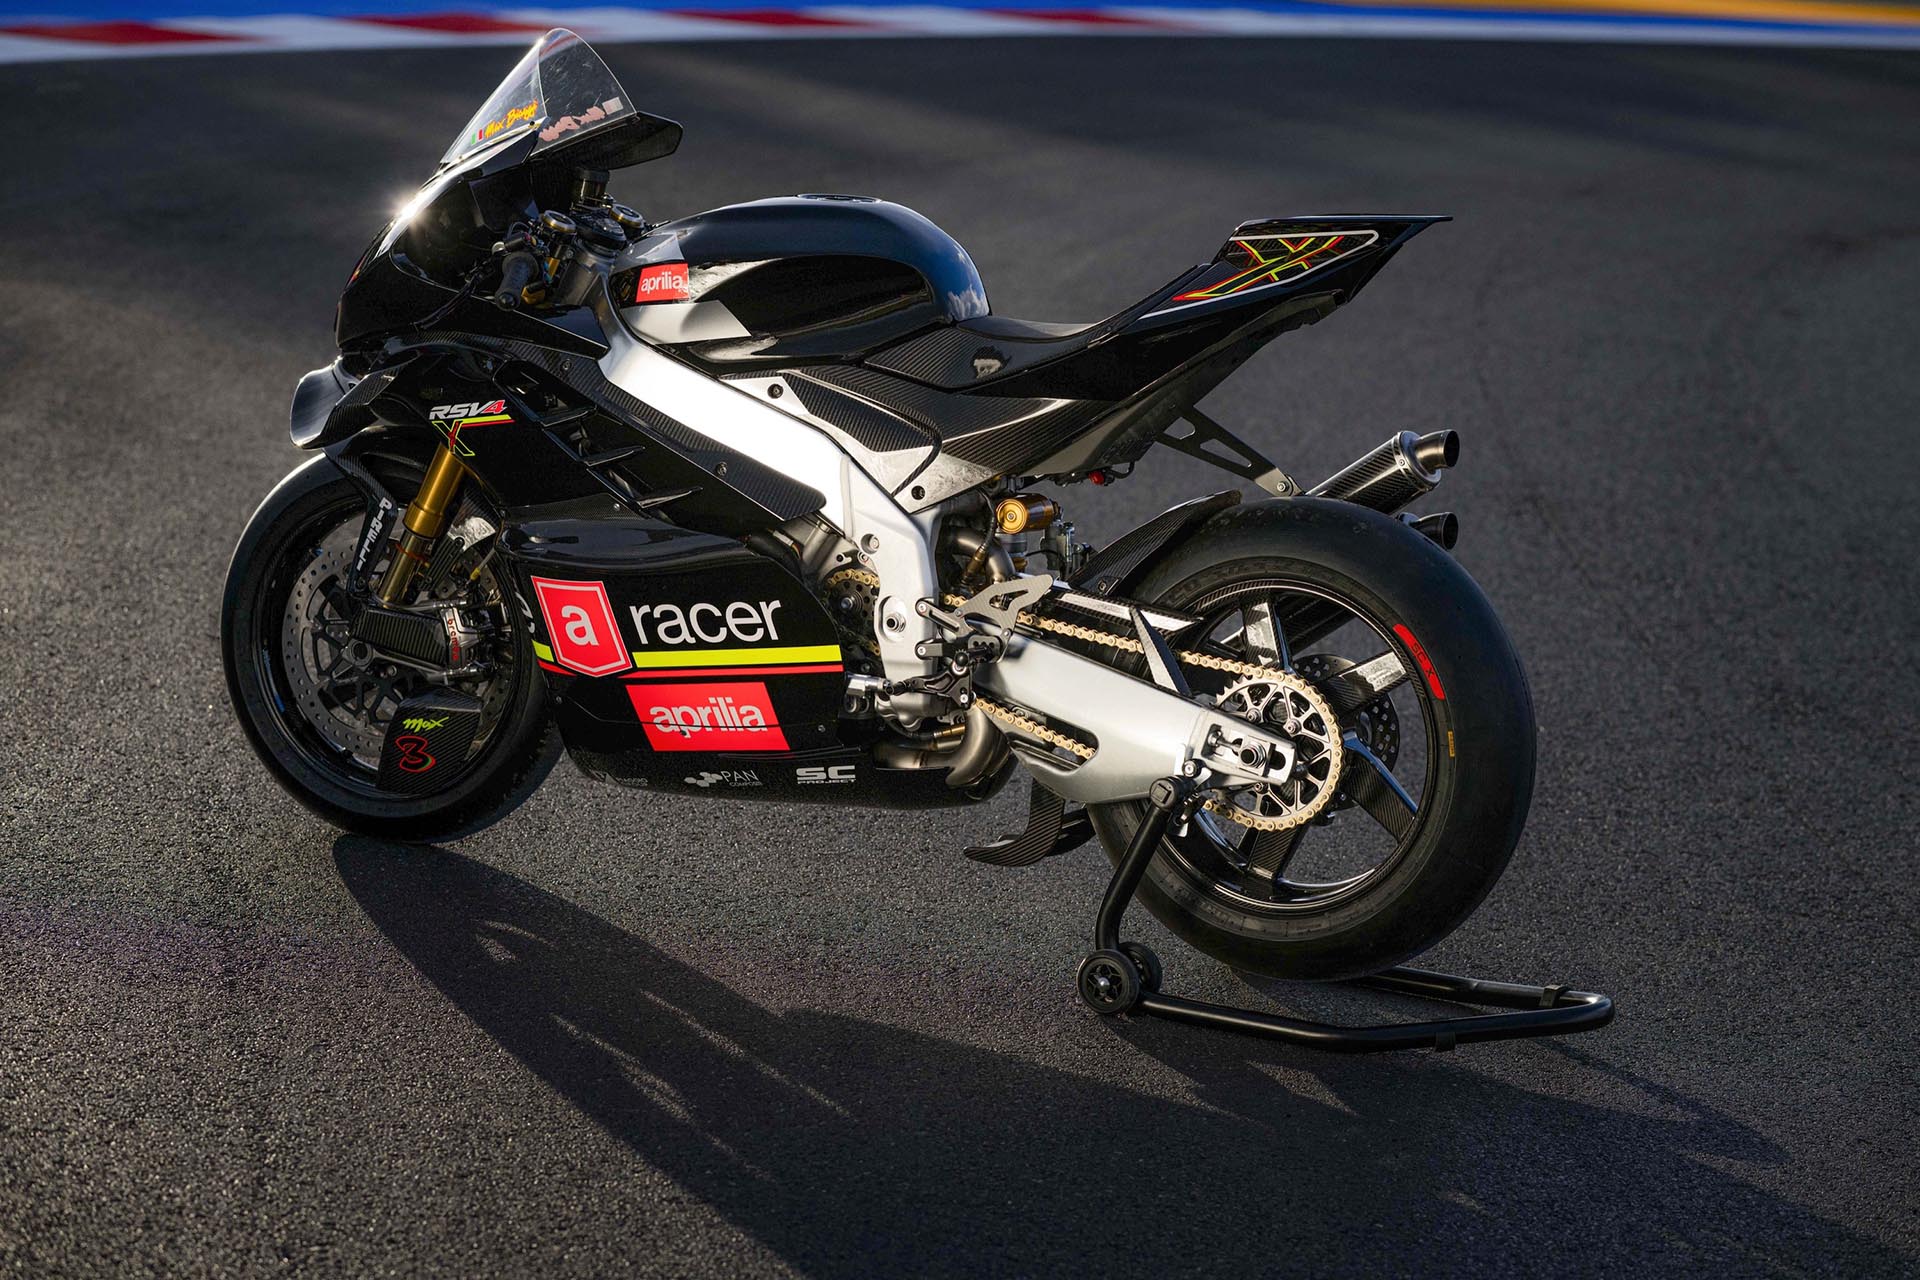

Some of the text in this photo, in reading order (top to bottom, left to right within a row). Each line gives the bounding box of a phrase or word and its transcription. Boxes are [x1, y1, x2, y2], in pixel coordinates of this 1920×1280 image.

[640, 272, 684, 294] aprilia
[429, 399, 507, 420] RSV4
[356, 496, 393, 571] PIRELLI
[561, 604, 600, 647] a
[629, 600, 783, 645] racer
[402, 716, 450, 733] max
[649, 696, 768, 739] aprilia
[395, 735, 437, 774] 3
[720, 769, 760, 783] PAN
[796, 764, 856, 780] SC
